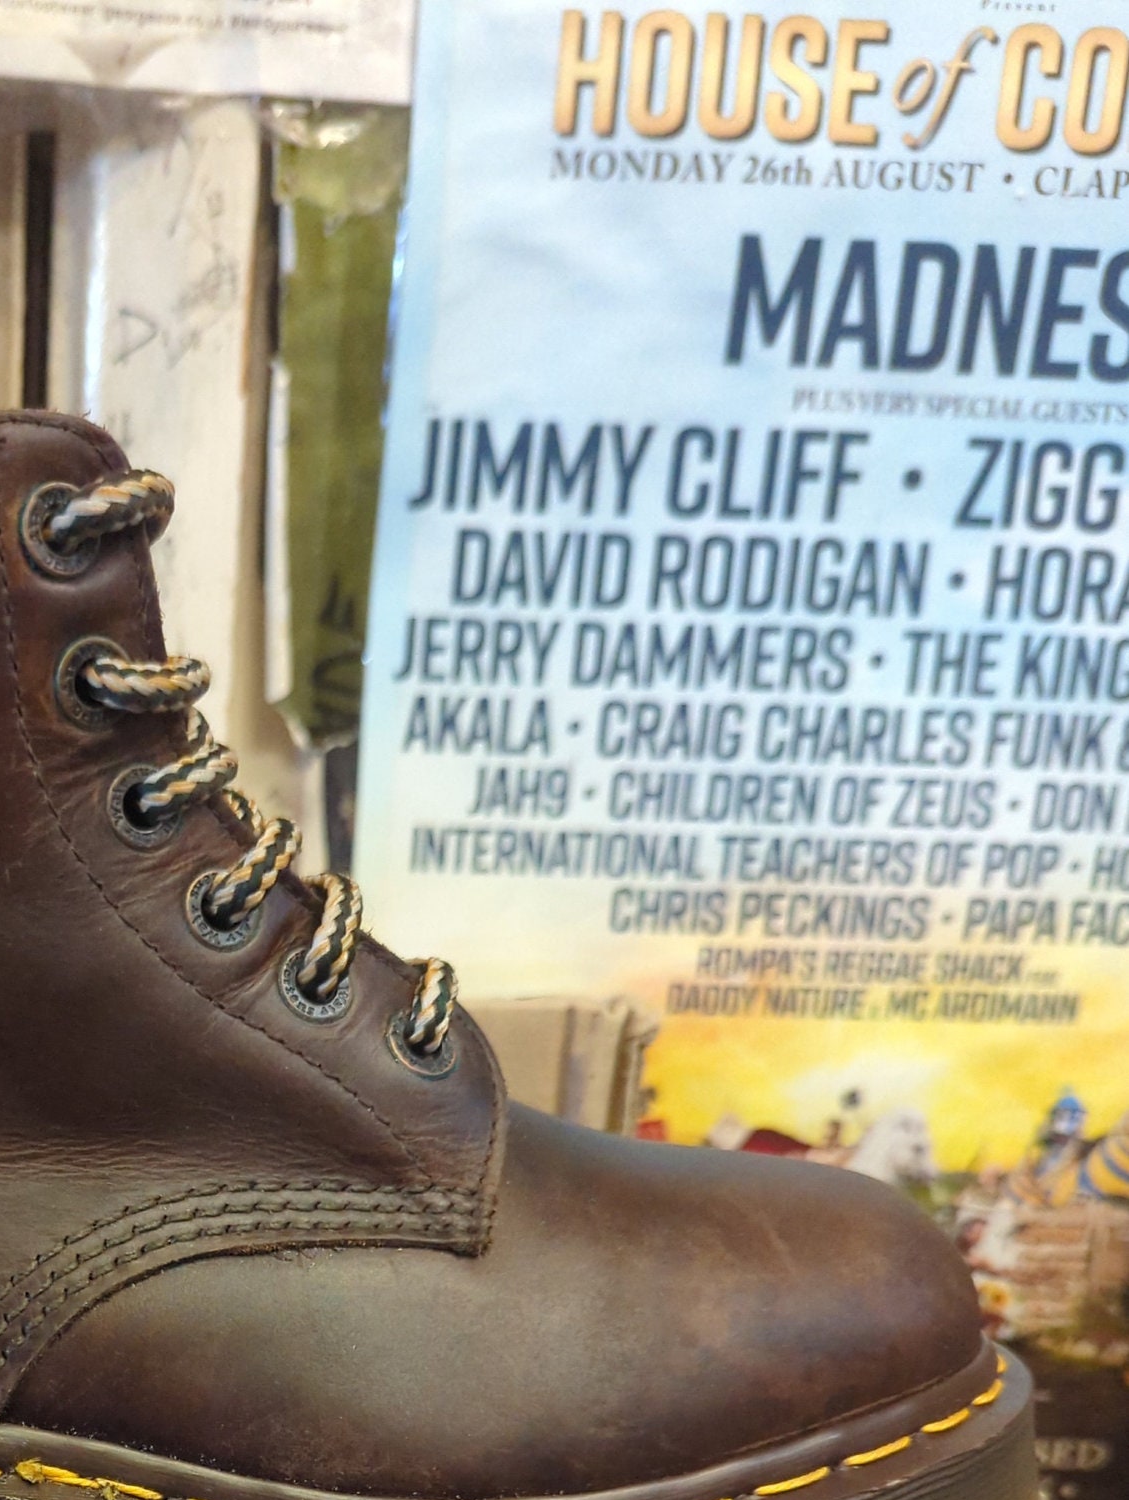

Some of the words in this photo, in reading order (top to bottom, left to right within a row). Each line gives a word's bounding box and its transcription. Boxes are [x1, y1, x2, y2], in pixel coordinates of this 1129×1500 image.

[552, 8, 890, 147] HOUSE
[894, 25, 998, 150] of
[995, 22, 1129, 155] CO
[550, 149, 732, 184] MONDAY
[742, 155, 813, 187] 26th
[825, 158, 985, 193] AUGUST
[1033, 165, 1129, 199] CLAP
[724, 233, 1129, 384] MADNES
[409, 418, 655, 515] JIMMY
[664, 425, 871, 523] CLIFF
[955, 436, 1128, 533] ZIGG
[451, 528, 633, 611] DAVID
[649, 533, 931, 618] RODIGAN
[393, 617, 560, 686] JERRY
[572, 620, 855, 693] DAMMERS
[904, 629, 1004, 698] THE
[1014, 634, 1129, 702] KING
[402, 694, 551, 755] AKALA
[596, 698, 746, 760] CRAIG
[758, 702, 975, 768] CHARLES
[983, 711, 1113, 772] FUNK
[469, 765, 571, 820] JAH9
[607, 770, 820, 825] CHILDREN
[830, 775, 885, 827] OF
[888, 777, 997, 830] ZEUS
[1030, 782, 1117, 833] DON
[409, 826, 704, 882] INTERNATIONAL
[717, 835, 918, 886] TEACHERS
[925, 841, 976, 888] OF
[982, 843, 1061, 890] POP
[608, 887, 727, 936] CHRIS
[736, 892, 931, 941] PECKINGS
[962, 898, 1058, 945] PAPA
[1067, 900, 1129, 947] FAC
[668, 982, 759, 1017] DADDY
[769, 985, 867, 1020] NATURE
[823, 948, 927, 984] REGGAE
[934, 951, 1027, 986] SHACK
